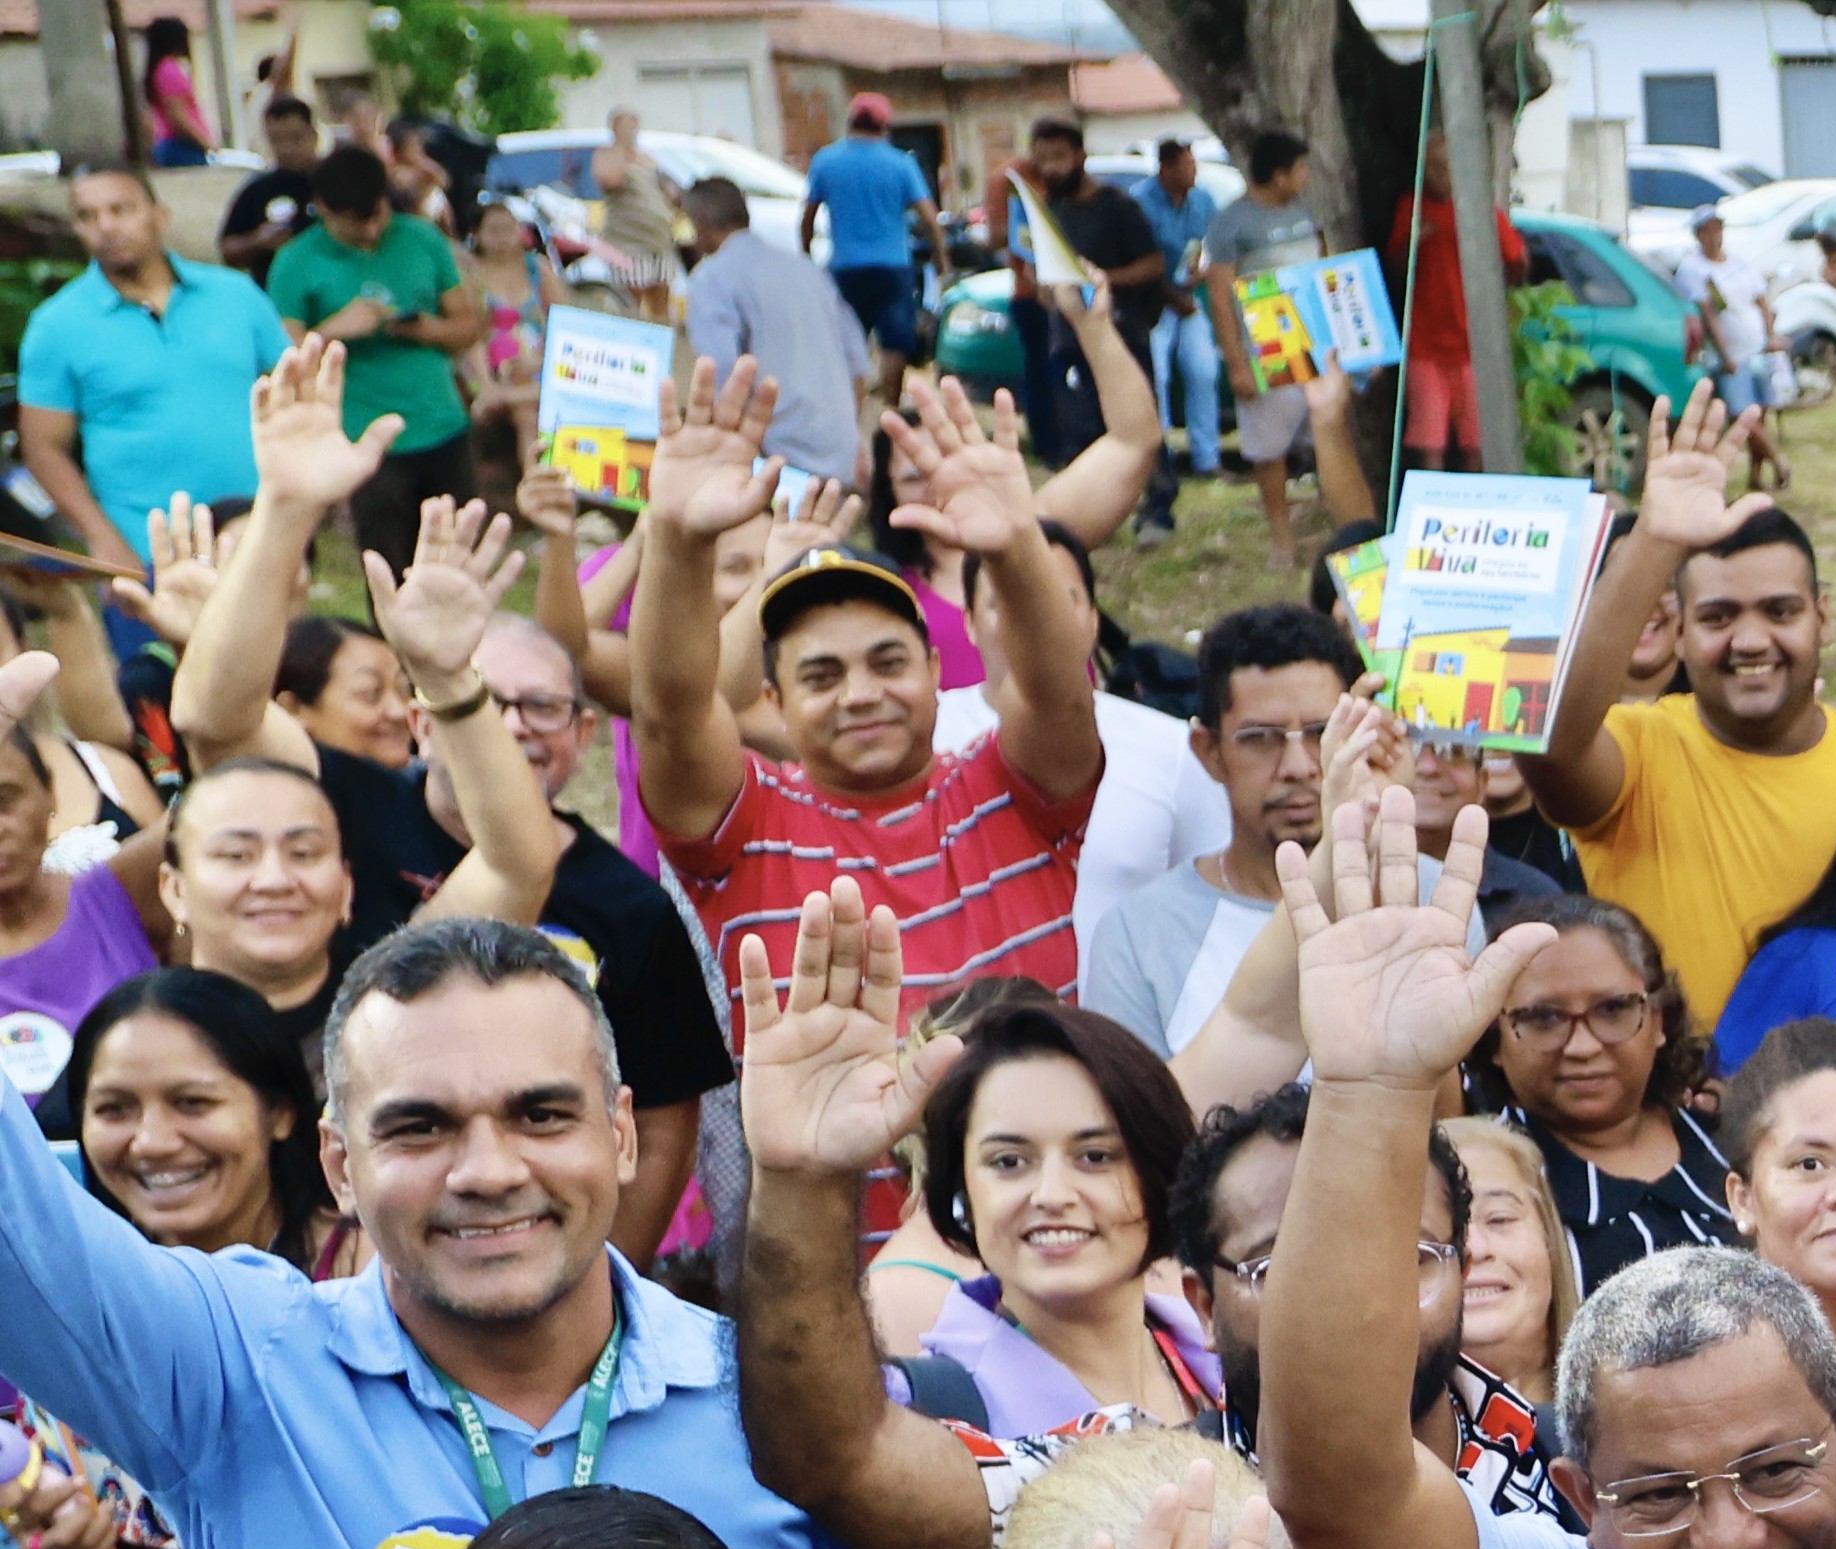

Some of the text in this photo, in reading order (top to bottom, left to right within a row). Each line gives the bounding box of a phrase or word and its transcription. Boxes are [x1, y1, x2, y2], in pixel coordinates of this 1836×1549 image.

[1421, 517, 1550, 548] Periferia
[1417, 547, 1477, 574] Viva
[456, 1400, 491, 1457] ALECE
[573, 1454, 594, 1487] ECE
